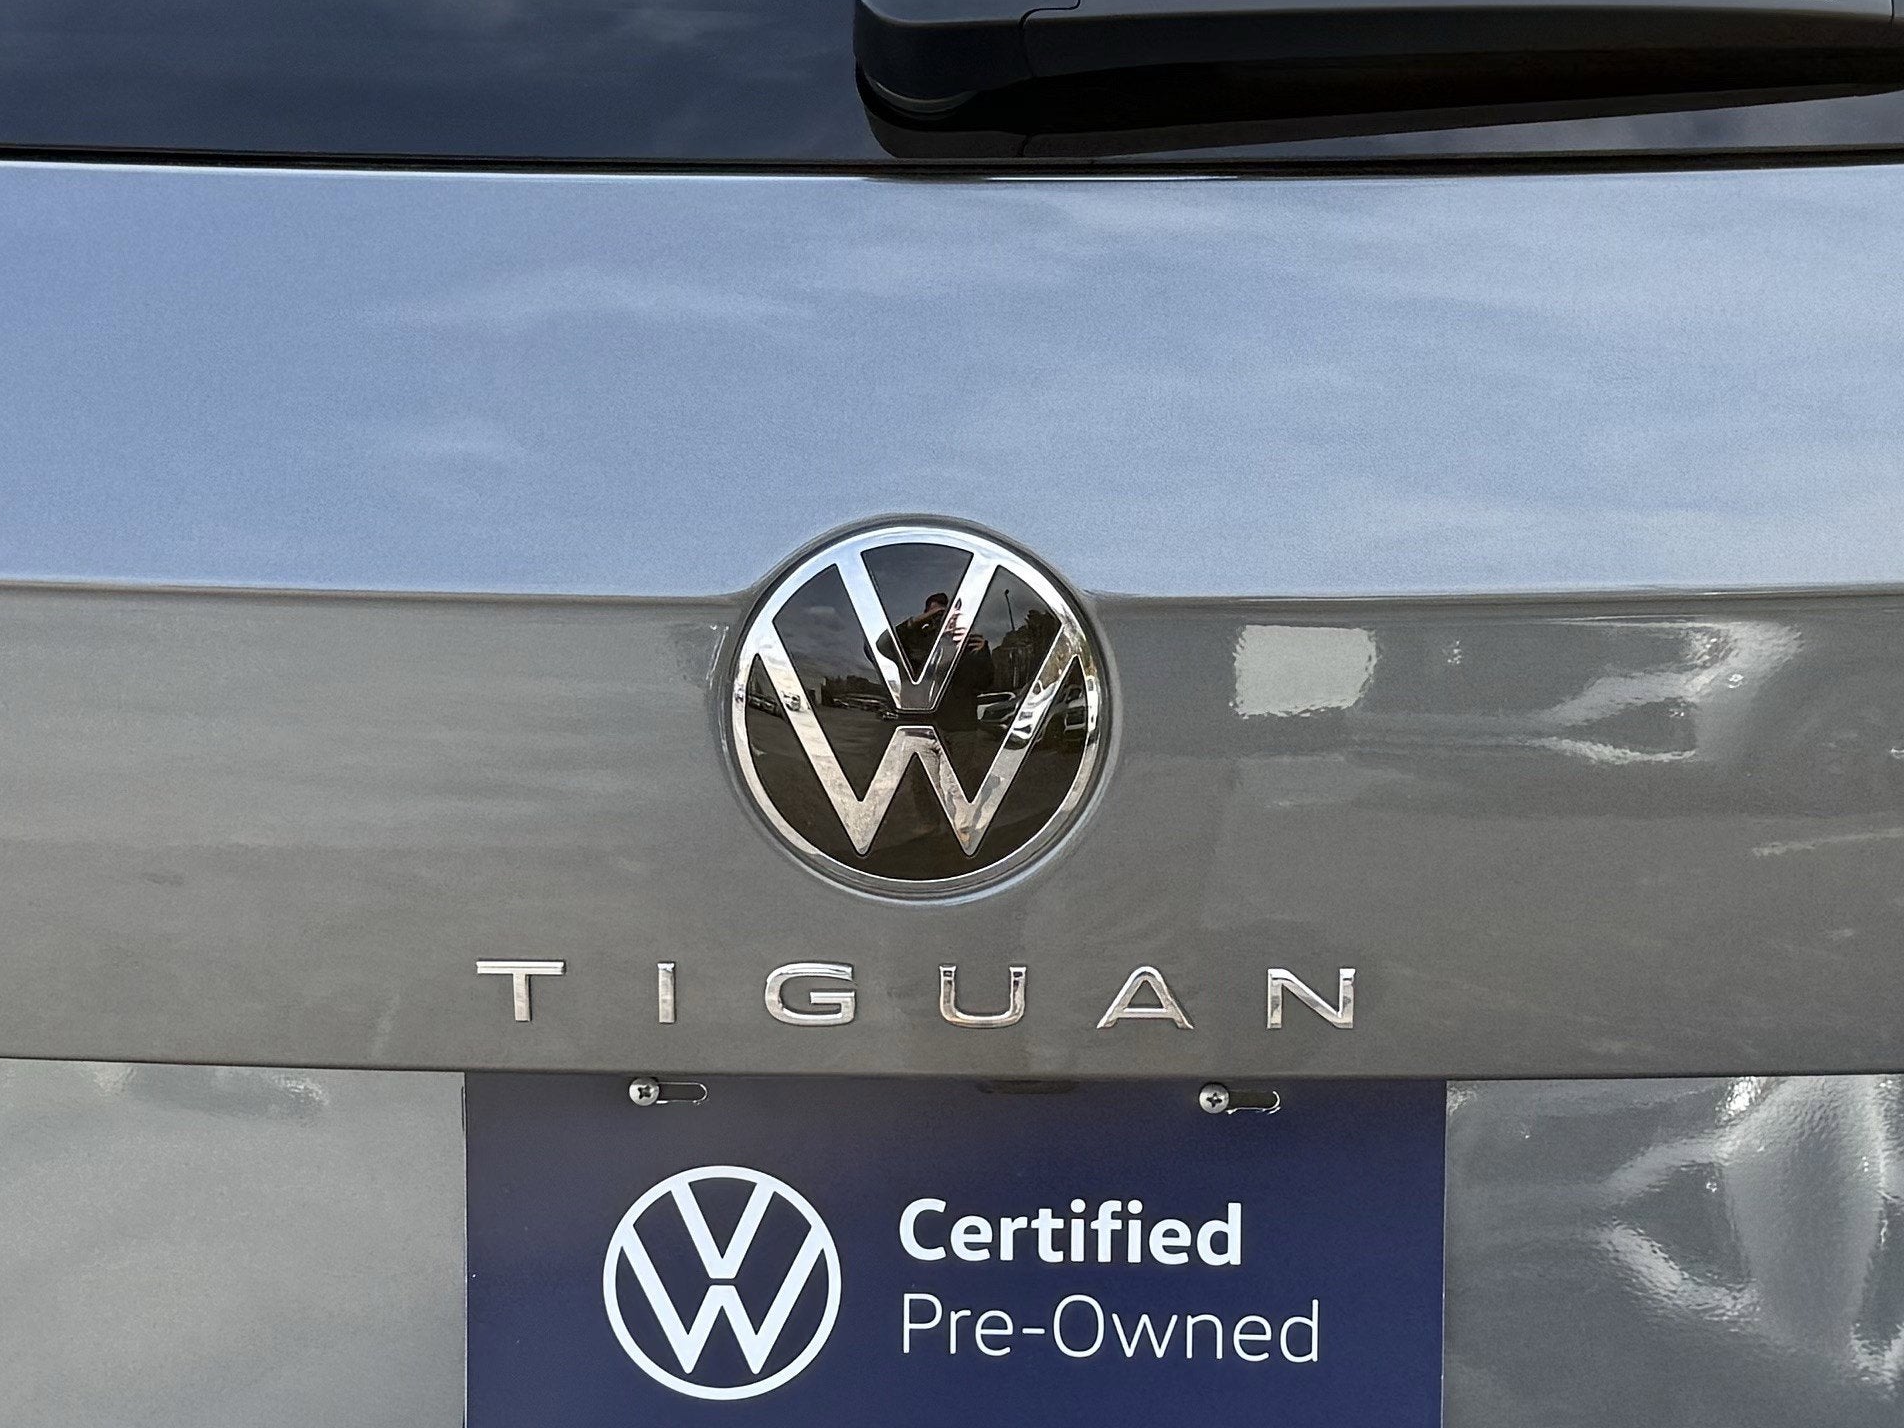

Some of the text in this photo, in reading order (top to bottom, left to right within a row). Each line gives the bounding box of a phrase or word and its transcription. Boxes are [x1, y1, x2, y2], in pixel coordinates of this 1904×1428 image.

[476, 959, 1357, 1030] TIGUAN
[899, 1197, 1243, 1267] Certified
[902, 1292, 1320, 1364] Pre-Owned
